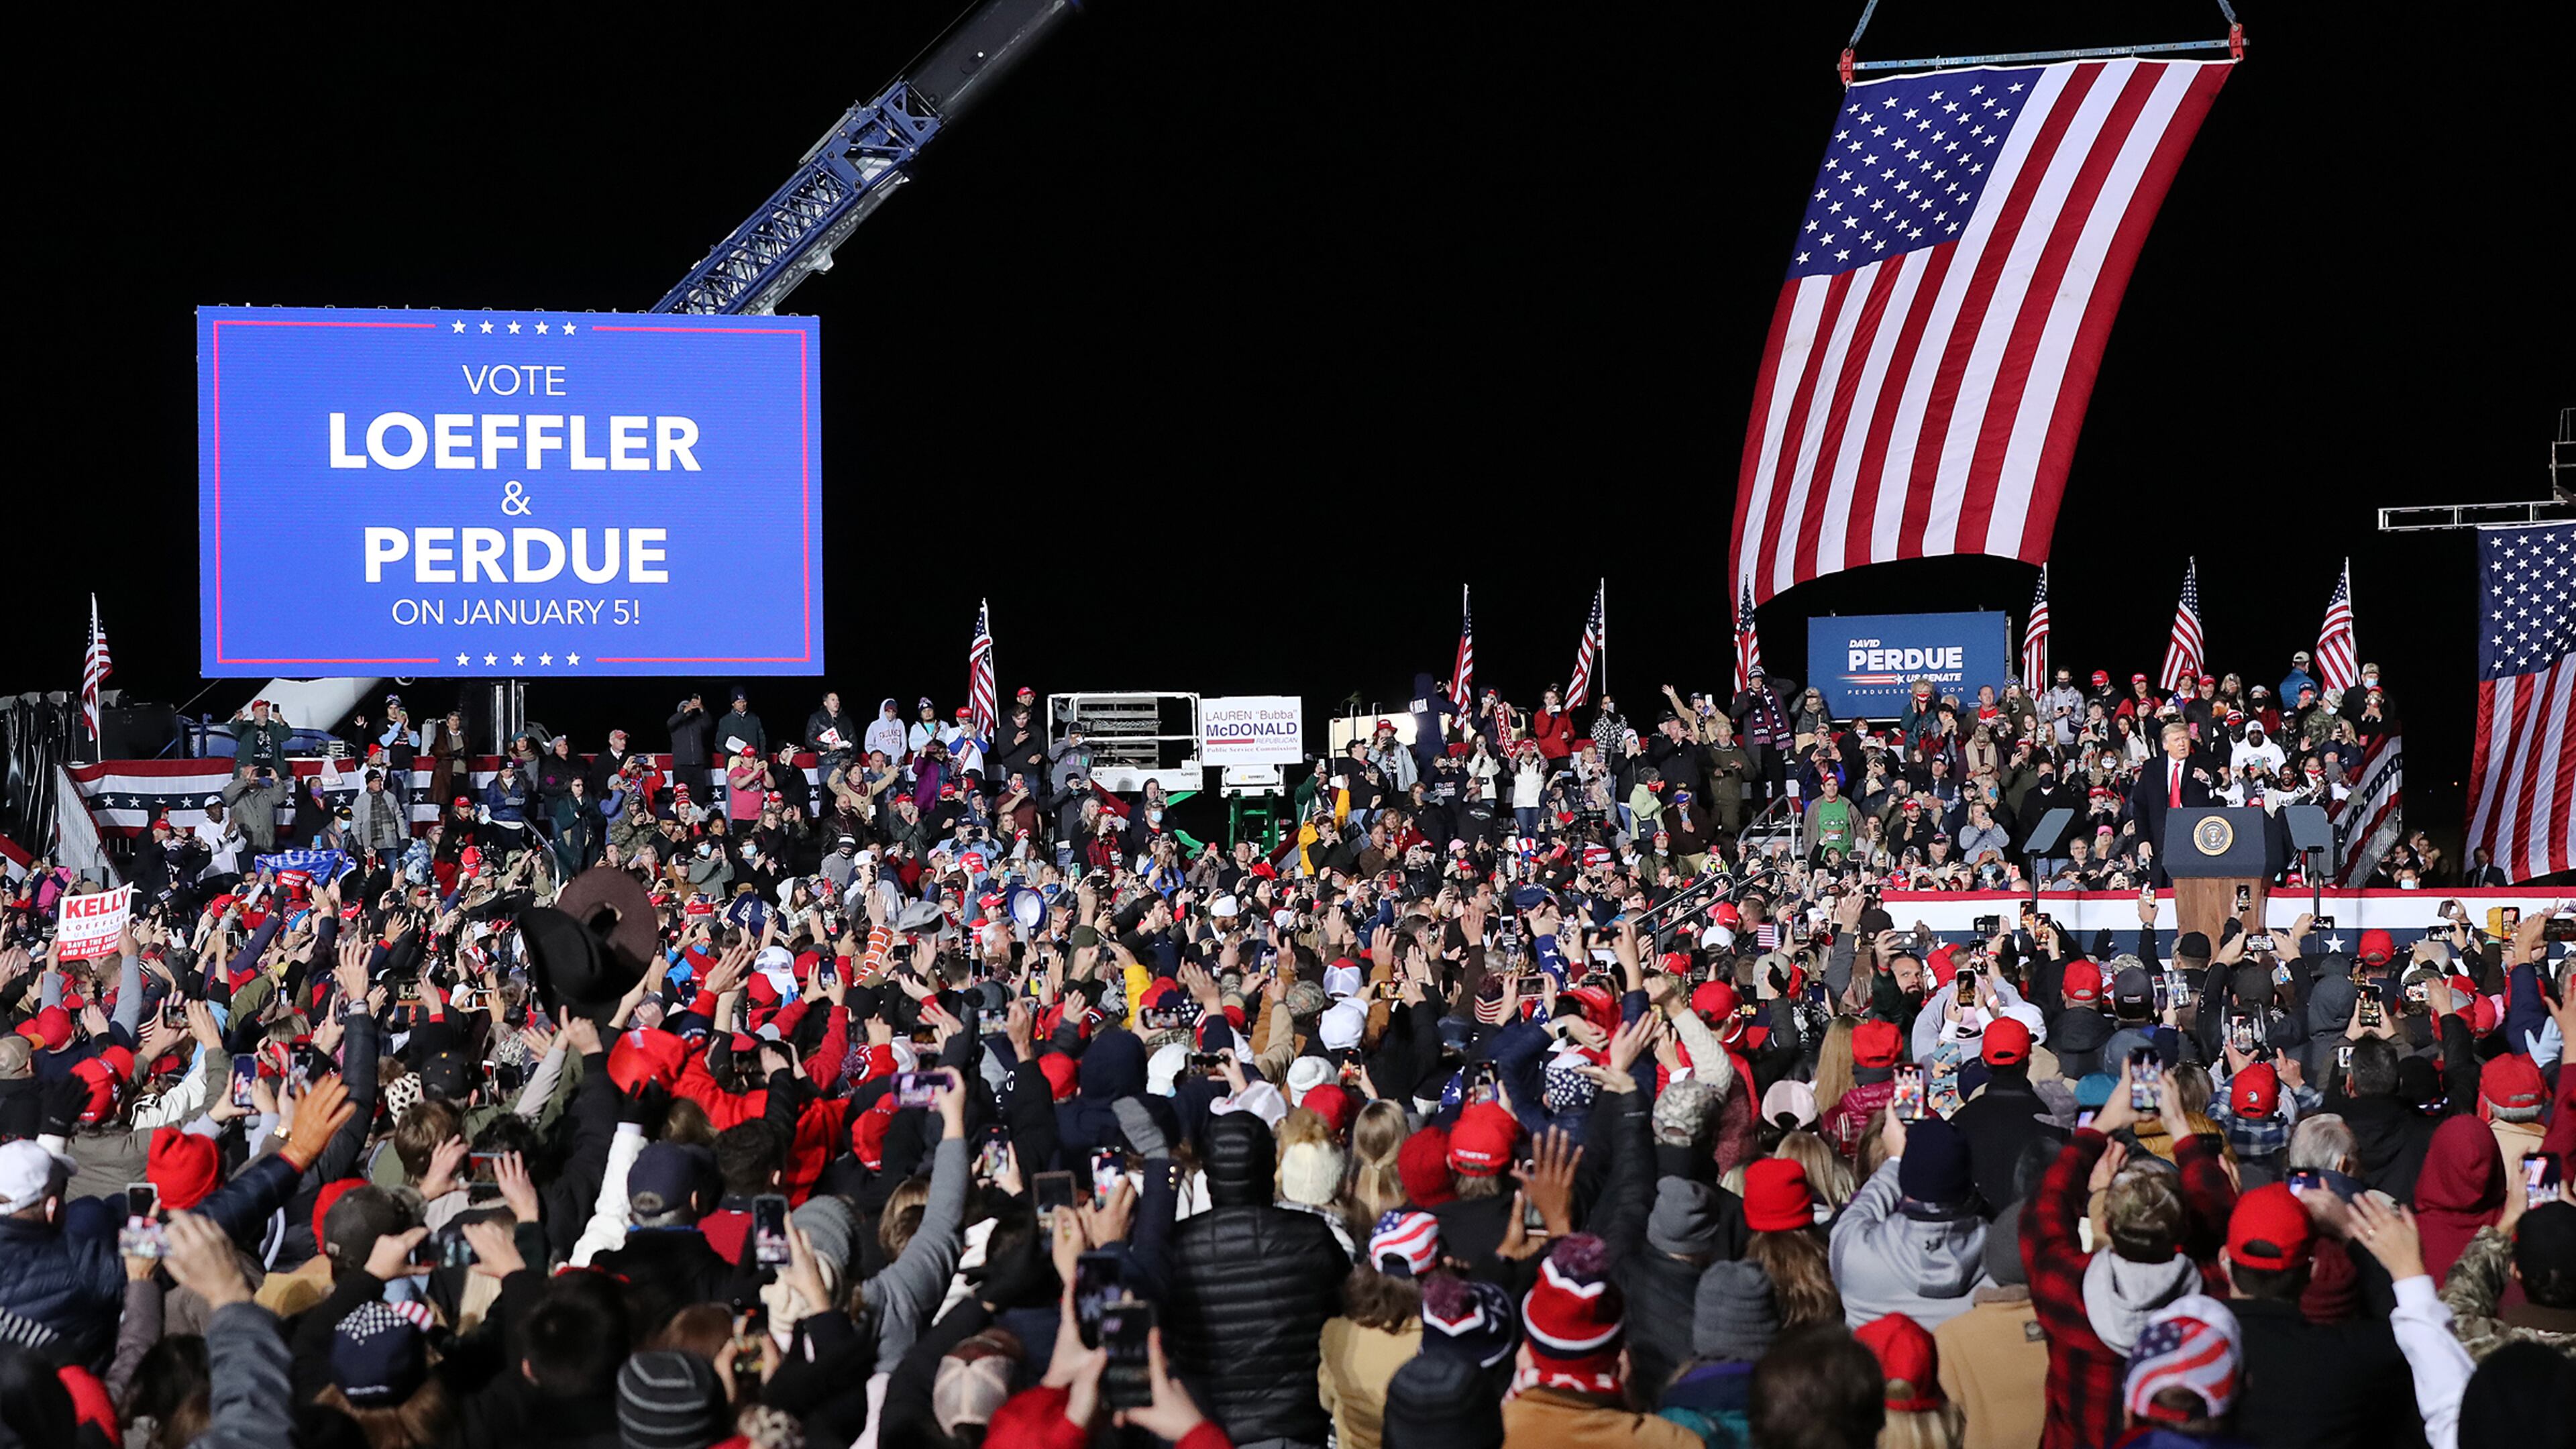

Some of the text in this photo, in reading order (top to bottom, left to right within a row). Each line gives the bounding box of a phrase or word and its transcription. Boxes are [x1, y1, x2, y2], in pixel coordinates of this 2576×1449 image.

[462, 365, 566, 396] VOTE
[329, 412, 702, 472] LOEFFLER
[501, 480, 532, 516] &
[364, 527, 669, 584] PERDUE
[392, 598, 640, 625] ON JANUARY 5!
[1849, 639, 1880, 648] DAVID
[1848, 647, 1963, 671] PERDUE
[1414, 698, 1428, 712] NBA
[1205, 710, 1252, 722] LAUREN
[1205, 722, 1297, 737] McDONALD
[1256, 737, 1298, 745] REPUBLICAN
[66, 888, 129, 919] KELLY
[66, 913, 125, 932] LOEFFLER
[61, 948, 78, 957] AND
[80, 945, 99, 954] SAVE
[67, 940, 87, 949] SAVE
[89, 937, 103, 947] THE
